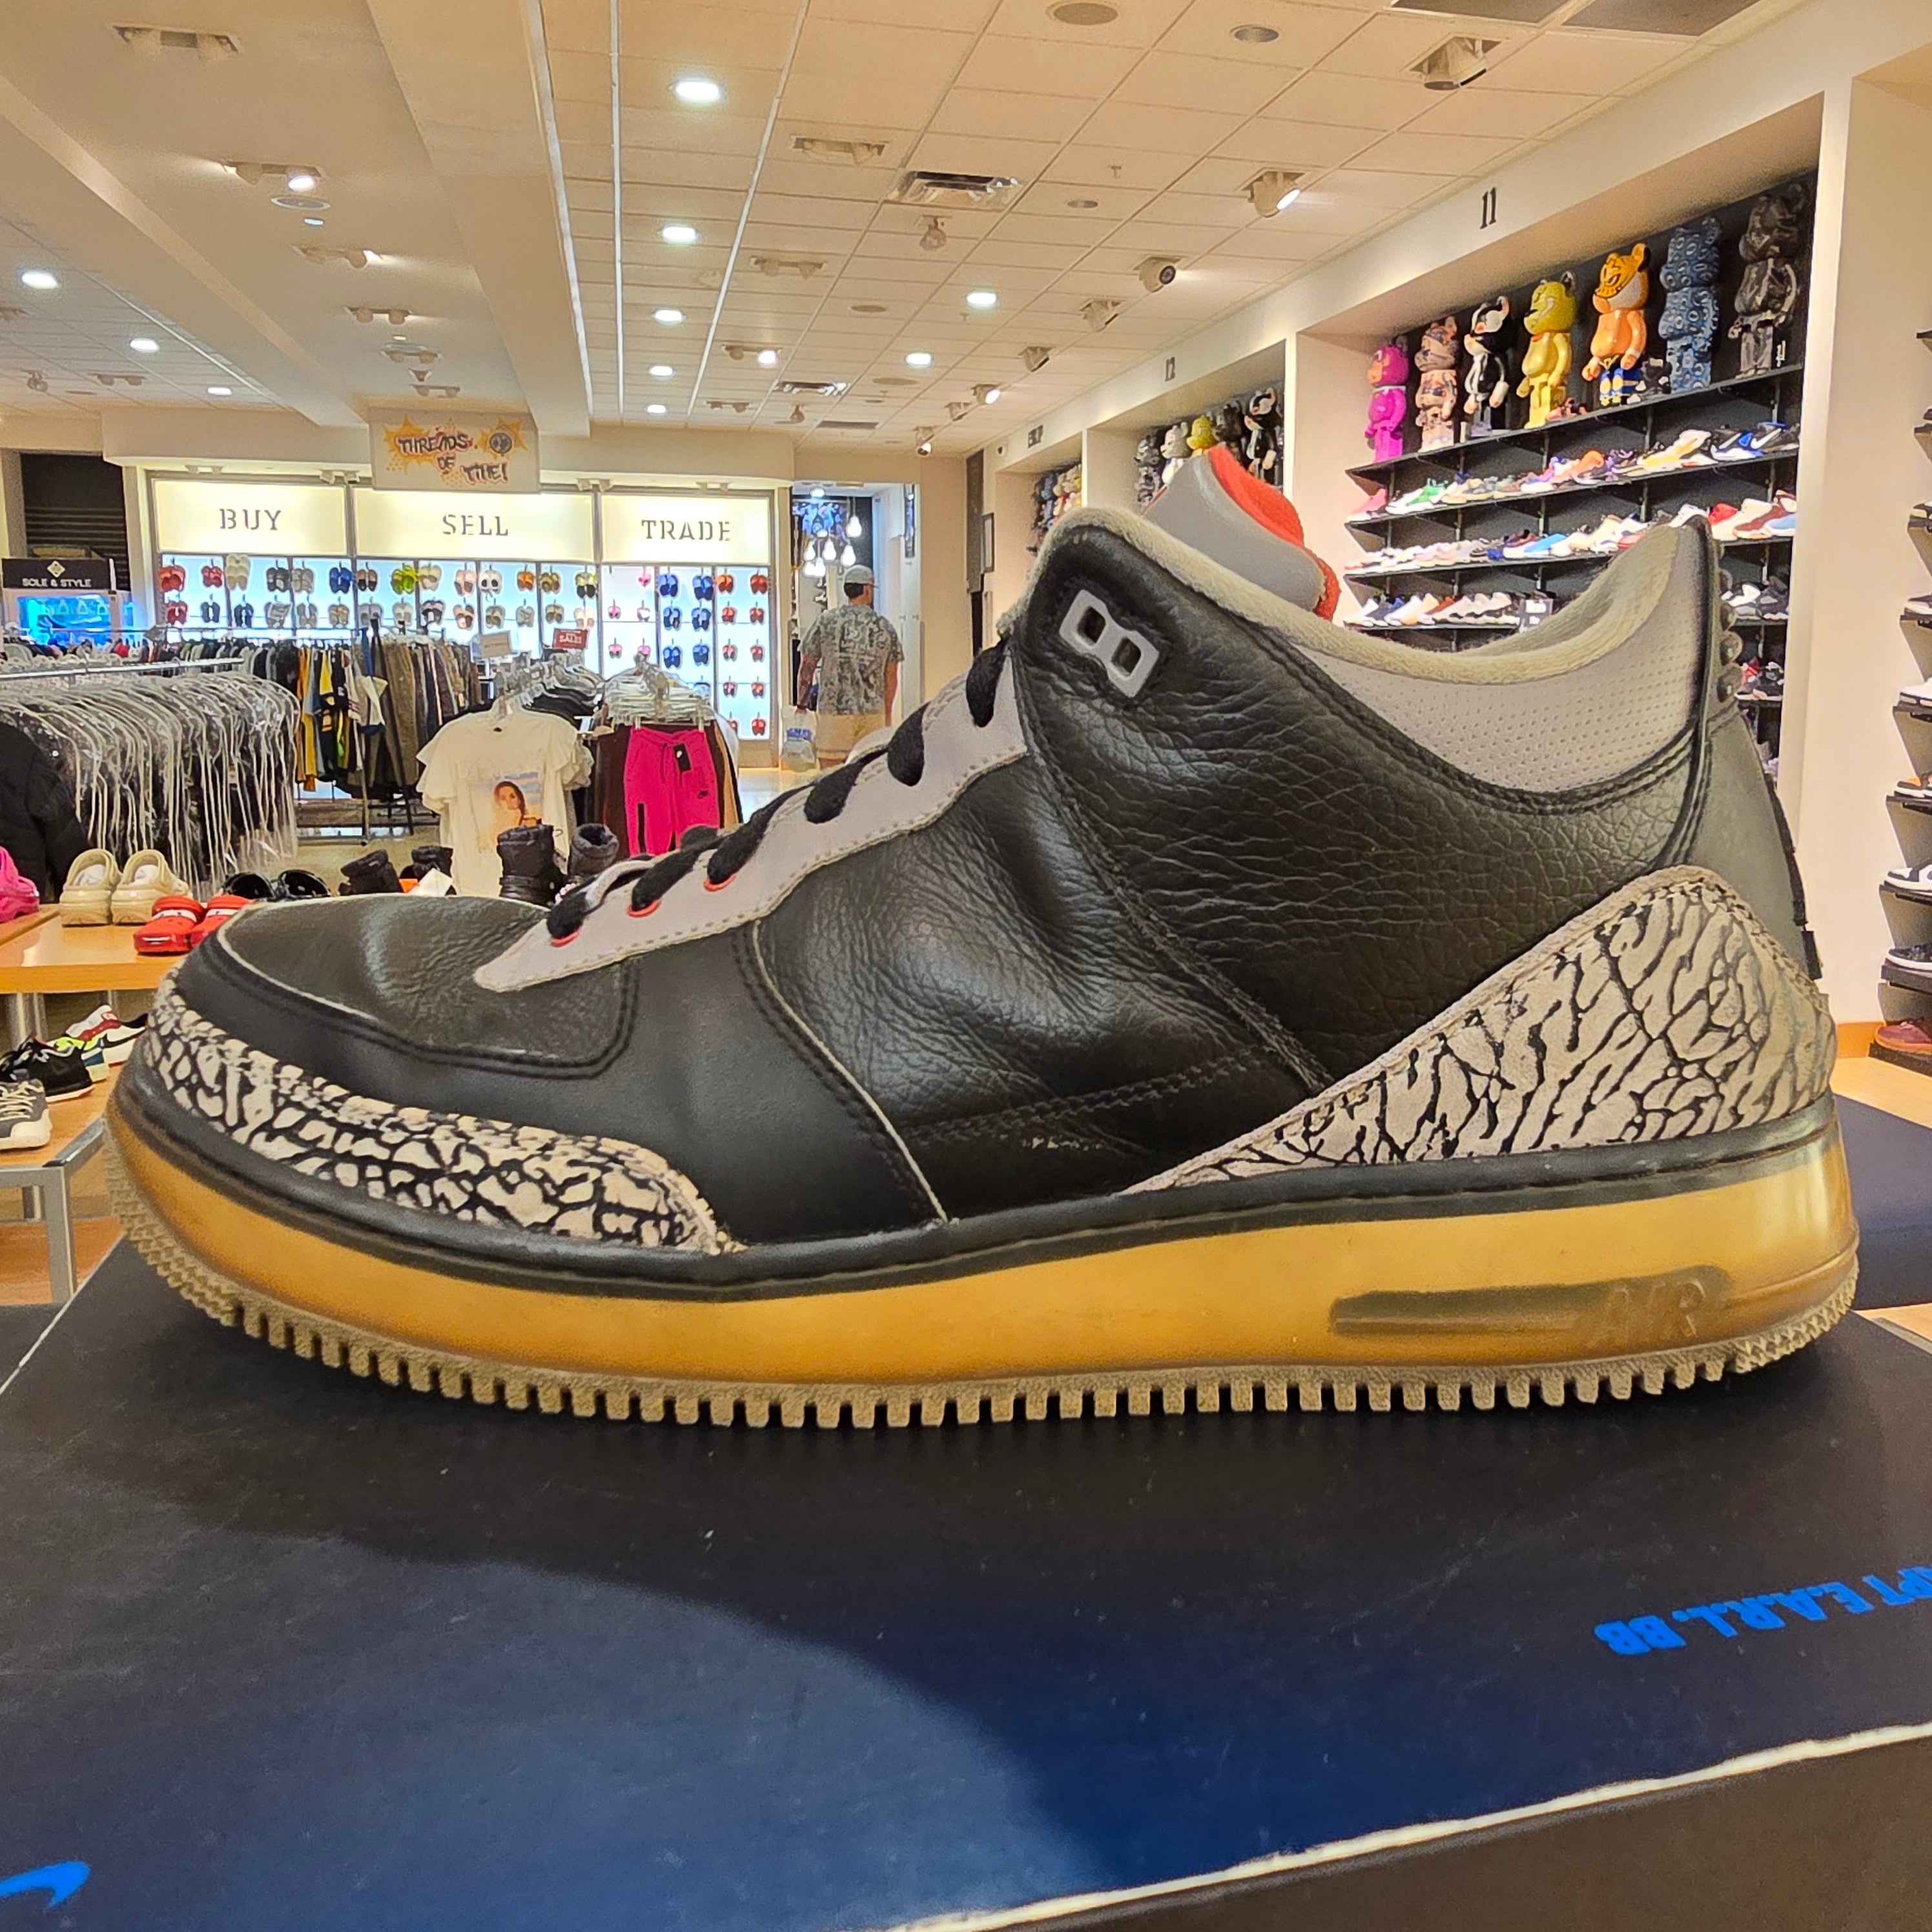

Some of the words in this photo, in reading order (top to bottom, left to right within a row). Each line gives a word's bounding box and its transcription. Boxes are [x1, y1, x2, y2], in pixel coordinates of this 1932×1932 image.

[1479, 187, 1497, 229] 11
[219, 508, 282, 531] BUY
[442, 514, 509, 536] SELL
[641, 519, 731, 541] TRADE
[22, 578, 48, 587] SOLE
[60, 579, 92, 588] STYLE
[1594, 1614, 1686, 1655] BB
